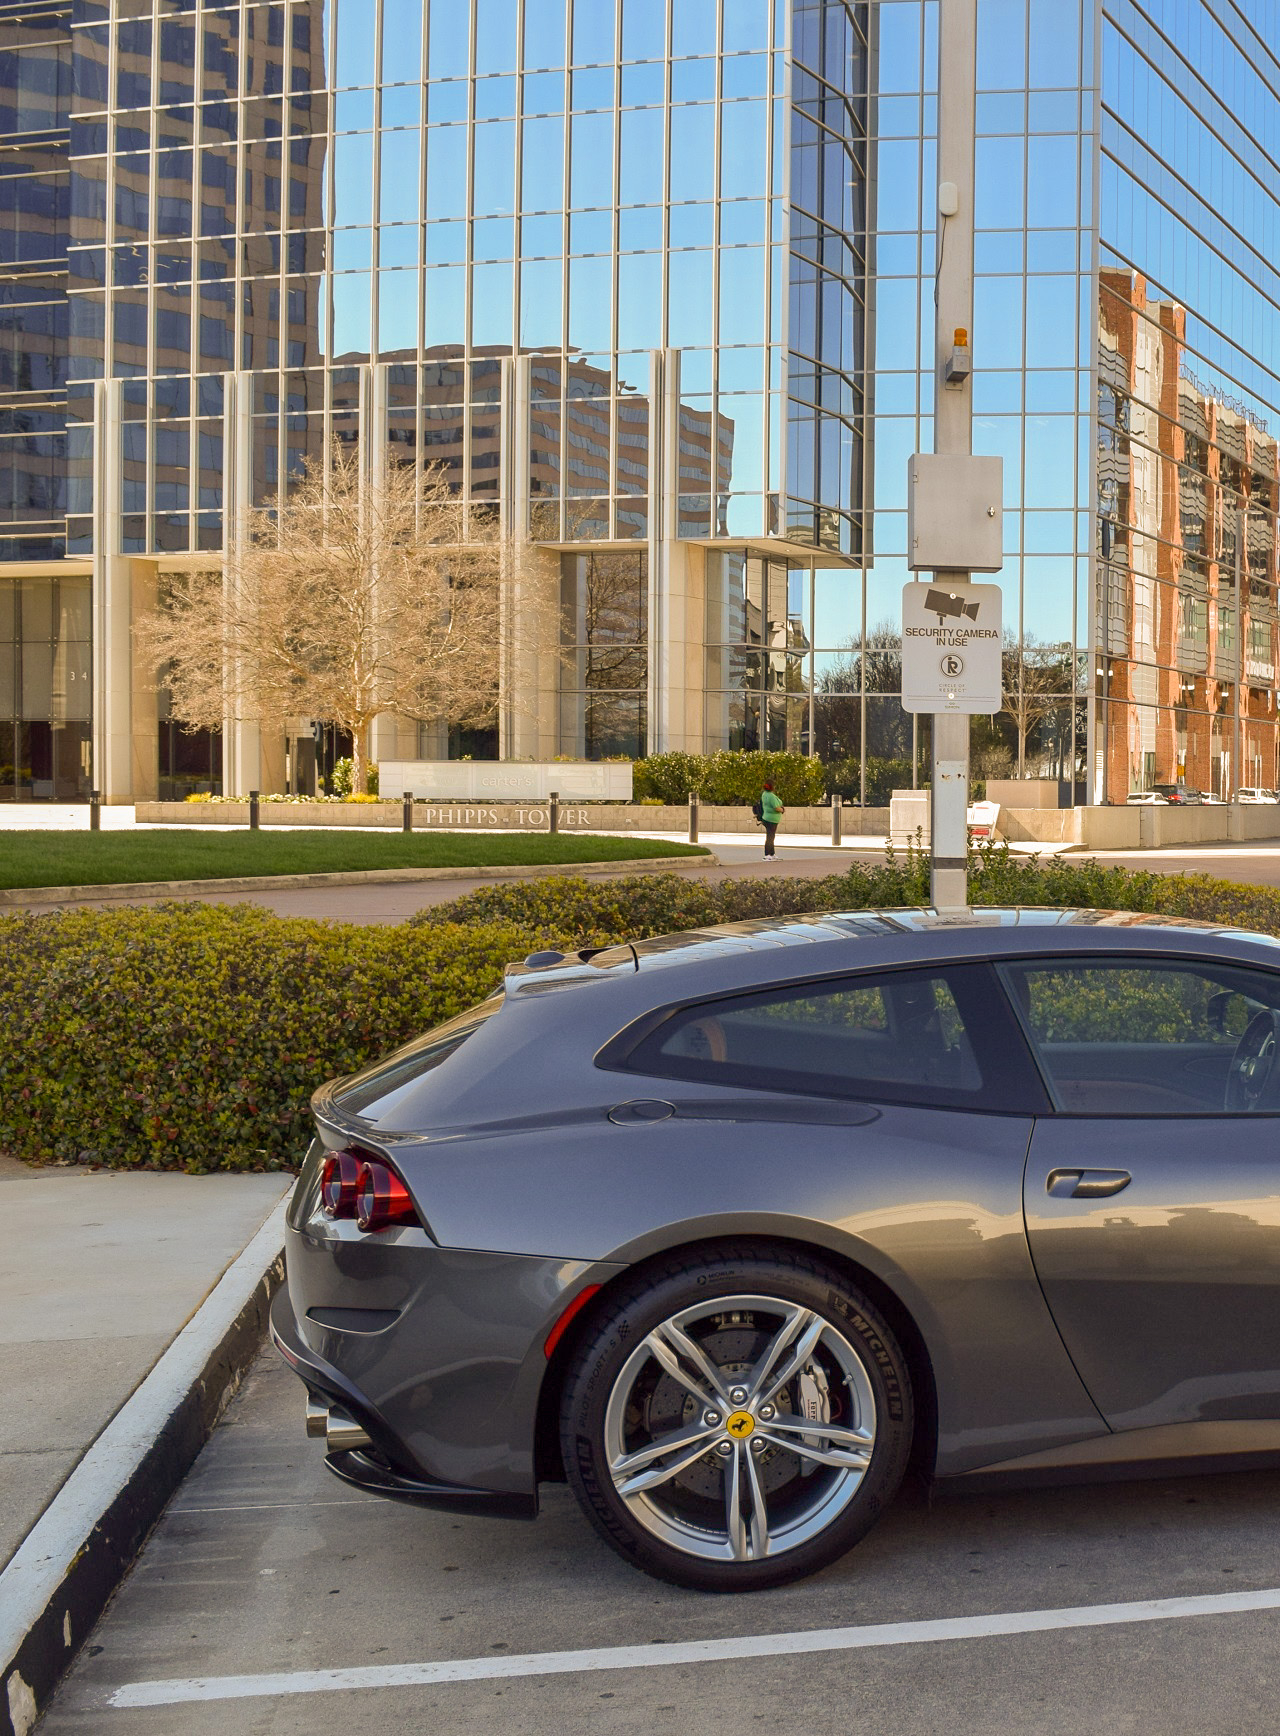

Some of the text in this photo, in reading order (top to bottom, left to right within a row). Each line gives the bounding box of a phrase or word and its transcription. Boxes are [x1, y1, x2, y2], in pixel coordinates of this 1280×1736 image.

[905, 627, 999, 639] SECURITY CAMERA
[936, 637, 968, 647] IN USE
[481, 775, 532, 786] carter's
[425, 808, 591, 826] PHIPPS TOWER
[587, 1354, 606, 1393] SPORT
[850, 1314, 903, 1419] MICHELIN
